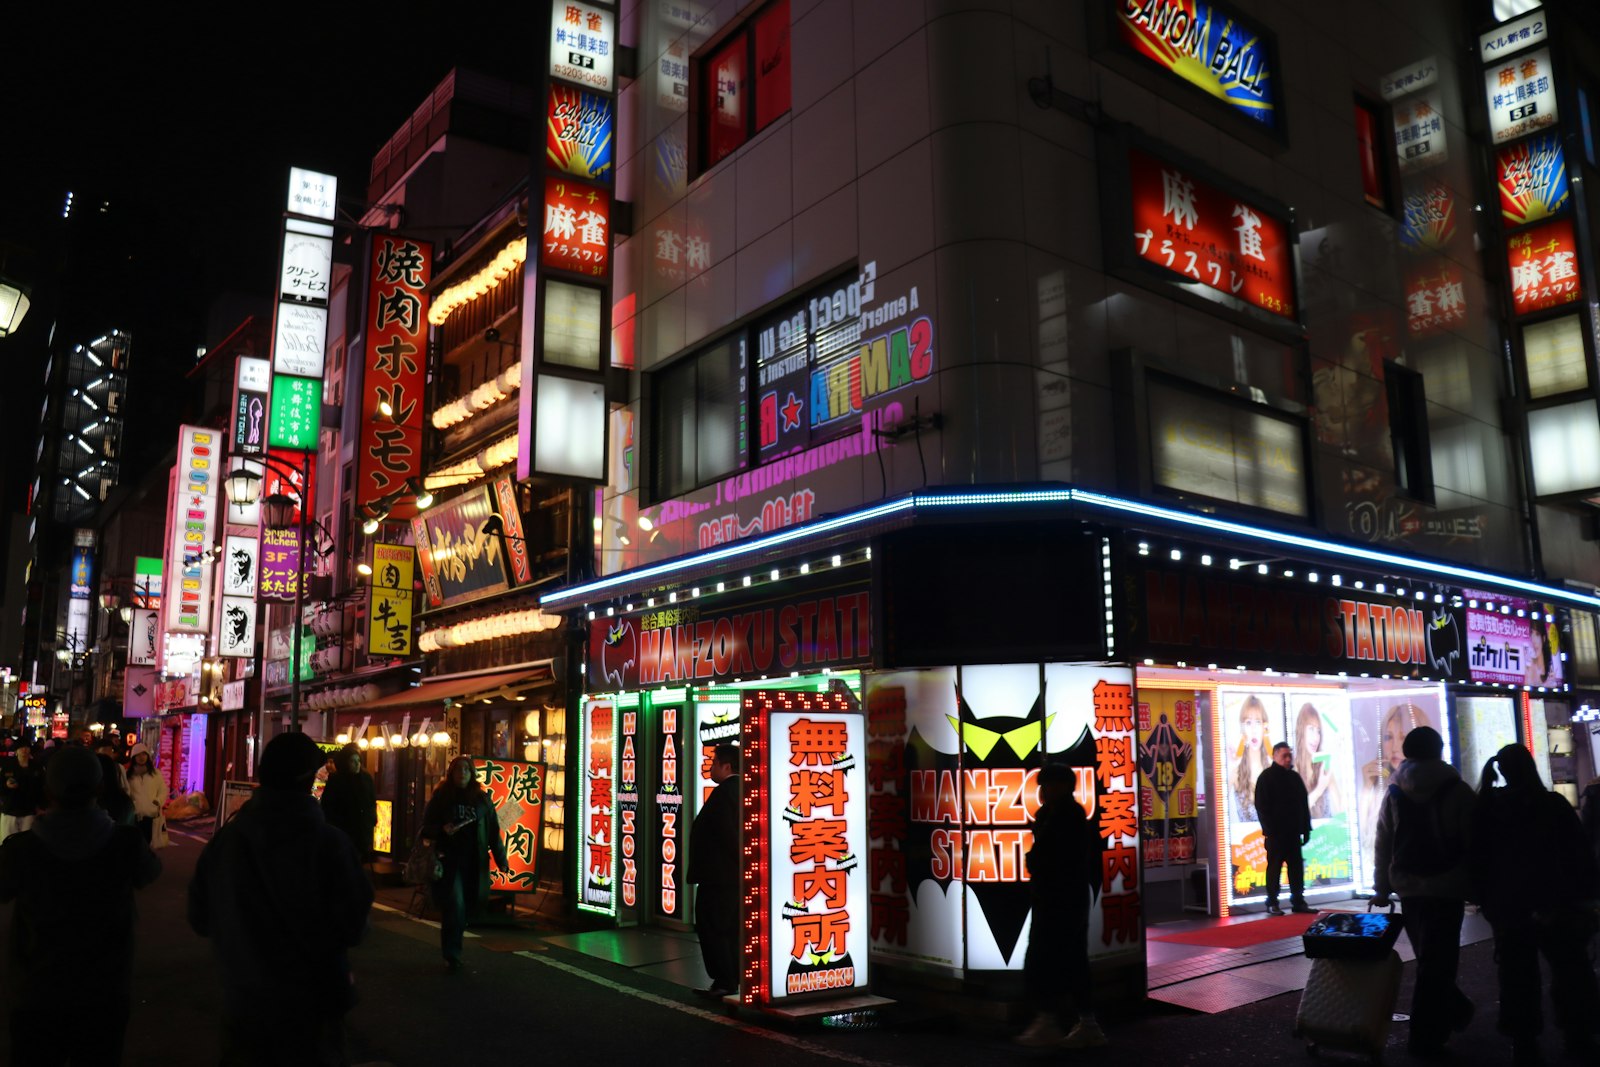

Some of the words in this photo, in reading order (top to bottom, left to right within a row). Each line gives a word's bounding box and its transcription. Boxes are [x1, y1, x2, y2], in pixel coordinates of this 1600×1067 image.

[564, 5, 603, 33] 麻雀
[1484, 21, 1545, 52] ベル新宿2
[571, 53, 592, 68] 5F
[1211, 36, 1265, 98] BALL
[1498, 58, 1539, 89] 麻雀
[554, 101, 611, 129] CANON
[1512, 103, 1536, 121] 5F
[558, 124, 602, 146] BALL
[1503, 146, 1559, 180] CANON
[556, 184, 599, 204] リーチ
[1512, 171, 1551, 197] BALL
[544, 203, 607, 246] 麻雀
[1161, 168, 1265, 262] 麻雀
[1521, 240, 1561, 260] リーチ
[286, 265, 319, 279] クリーン
[292, 278, 327, 292] サービス
[1512, 251, 1577, 292] 麻雀
[365, 239, 426, 515] 焼肉ホルモン
[188, 431, 213, 496] ROBOT
[243, 444, 260, 454] 3F
[265, 551, 288, 563] 3F
[1325, 597, 1427, 665] STATION
[1471, 635, 1521, 671] ポケパラ
[662, 708, 677, 784] MAN
[589, 705, 613, 879] 無料案内所
[504, 765, 541, 865] 焼肉
[867, 685, 910, 947] 無料案内所
[1092, 680, 1142, 947] 無料案内所
[789, 718, 849, 959] 無料案内所
[662, 812, 676, 915] ZOKU
